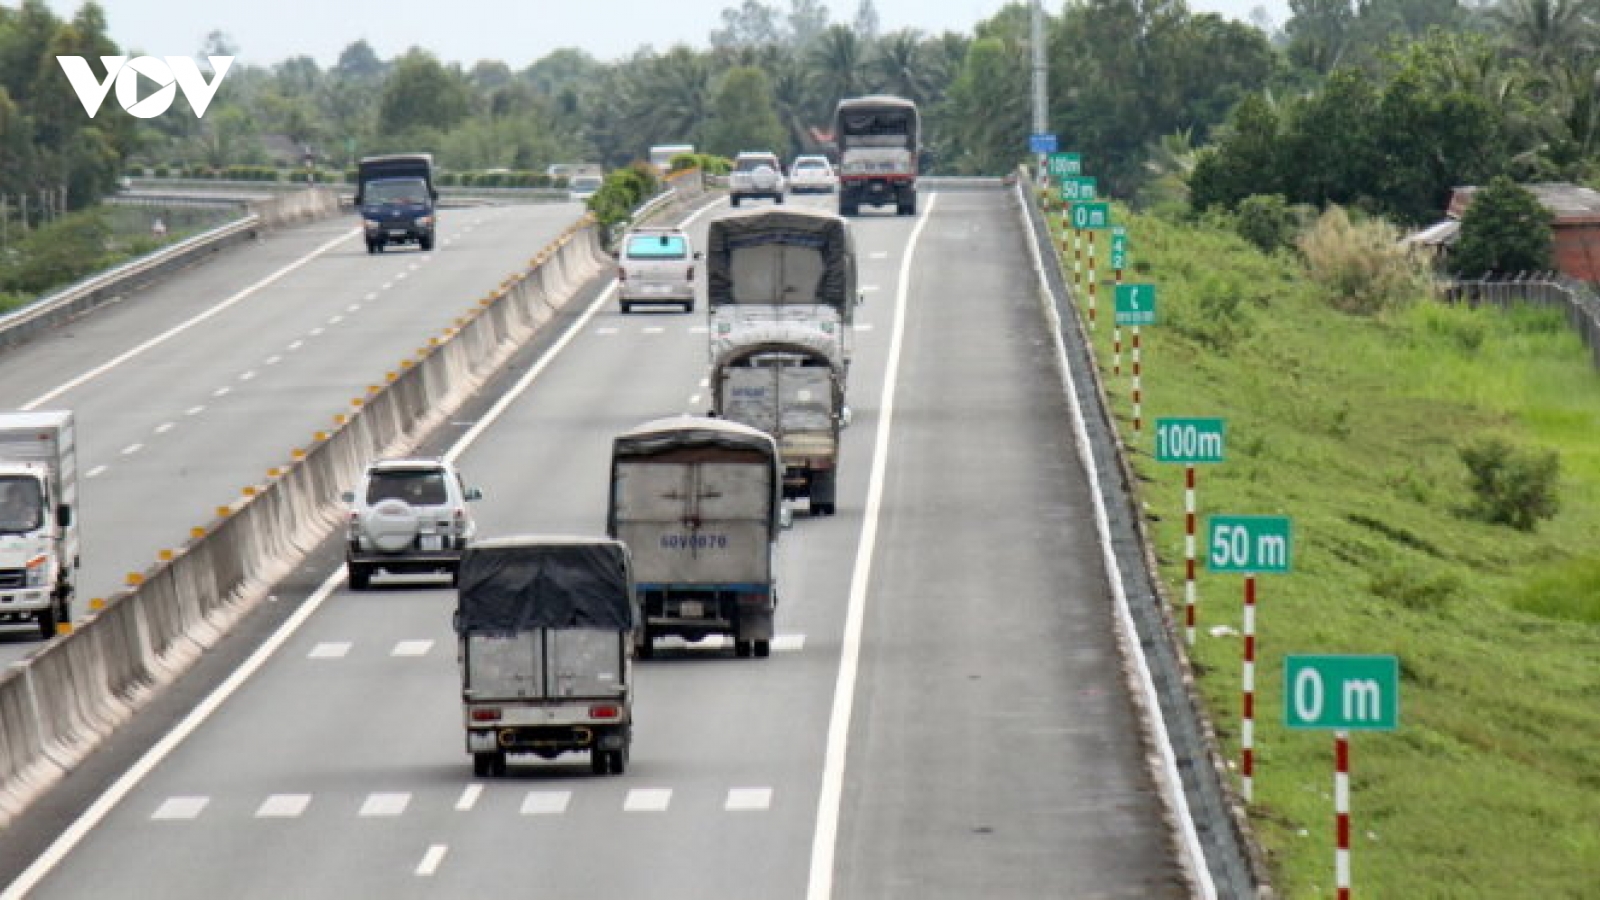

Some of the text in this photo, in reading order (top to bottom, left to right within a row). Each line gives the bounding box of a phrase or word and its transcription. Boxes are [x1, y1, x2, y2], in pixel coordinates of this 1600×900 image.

[1076, 207, 1104, 225] 0 m
[1158, 425, 1222, 457] 100m
[1212, 525, 1286, 566] 50 m
[1294, 667, 1382, 721] 0 m
